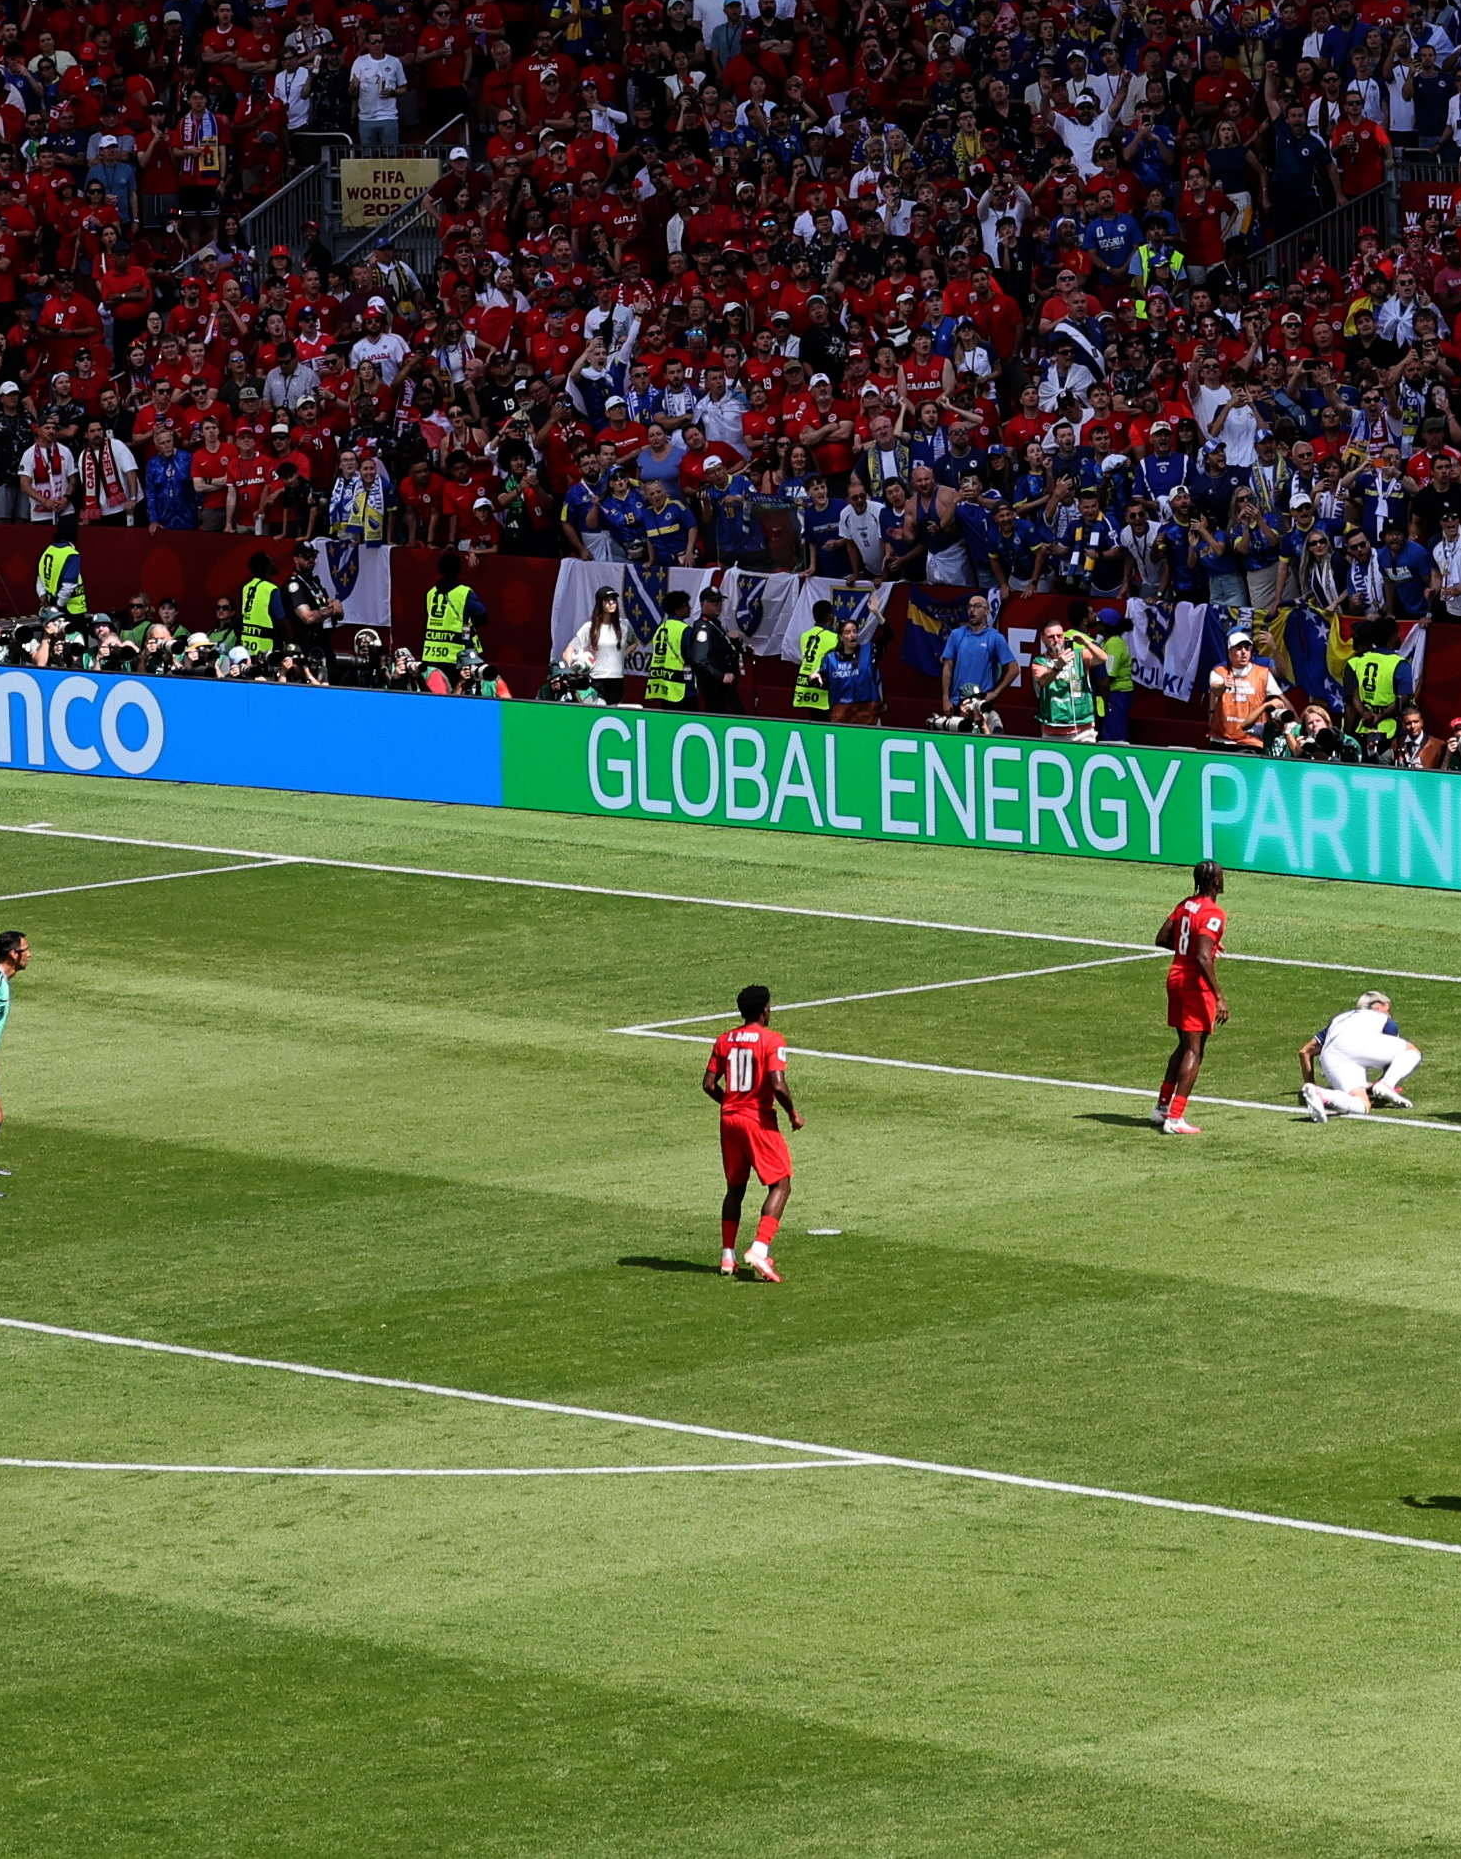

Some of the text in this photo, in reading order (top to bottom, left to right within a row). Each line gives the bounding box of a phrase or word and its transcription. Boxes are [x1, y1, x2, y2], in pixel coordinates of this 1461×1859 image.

[373, 170, 405, 184] FIFA
[347, 186, 401, 200] WORLD
[907, 379, 943, 391] CANADA
[502, 398, 516, 412] 19
[235, 476, 266, 486] CANADA
[624, 513, 635, 525] 19
[425, 630, 456, 642] CURITY
[588, 715, 863, 831] GLOBAL
[880, 738, 1179, 854] ENERGY
[1178, 915, 1190, 956] 8
[736, 1031, 760, 1043] DAVID
[727, 1047, 754, 1092] 10
